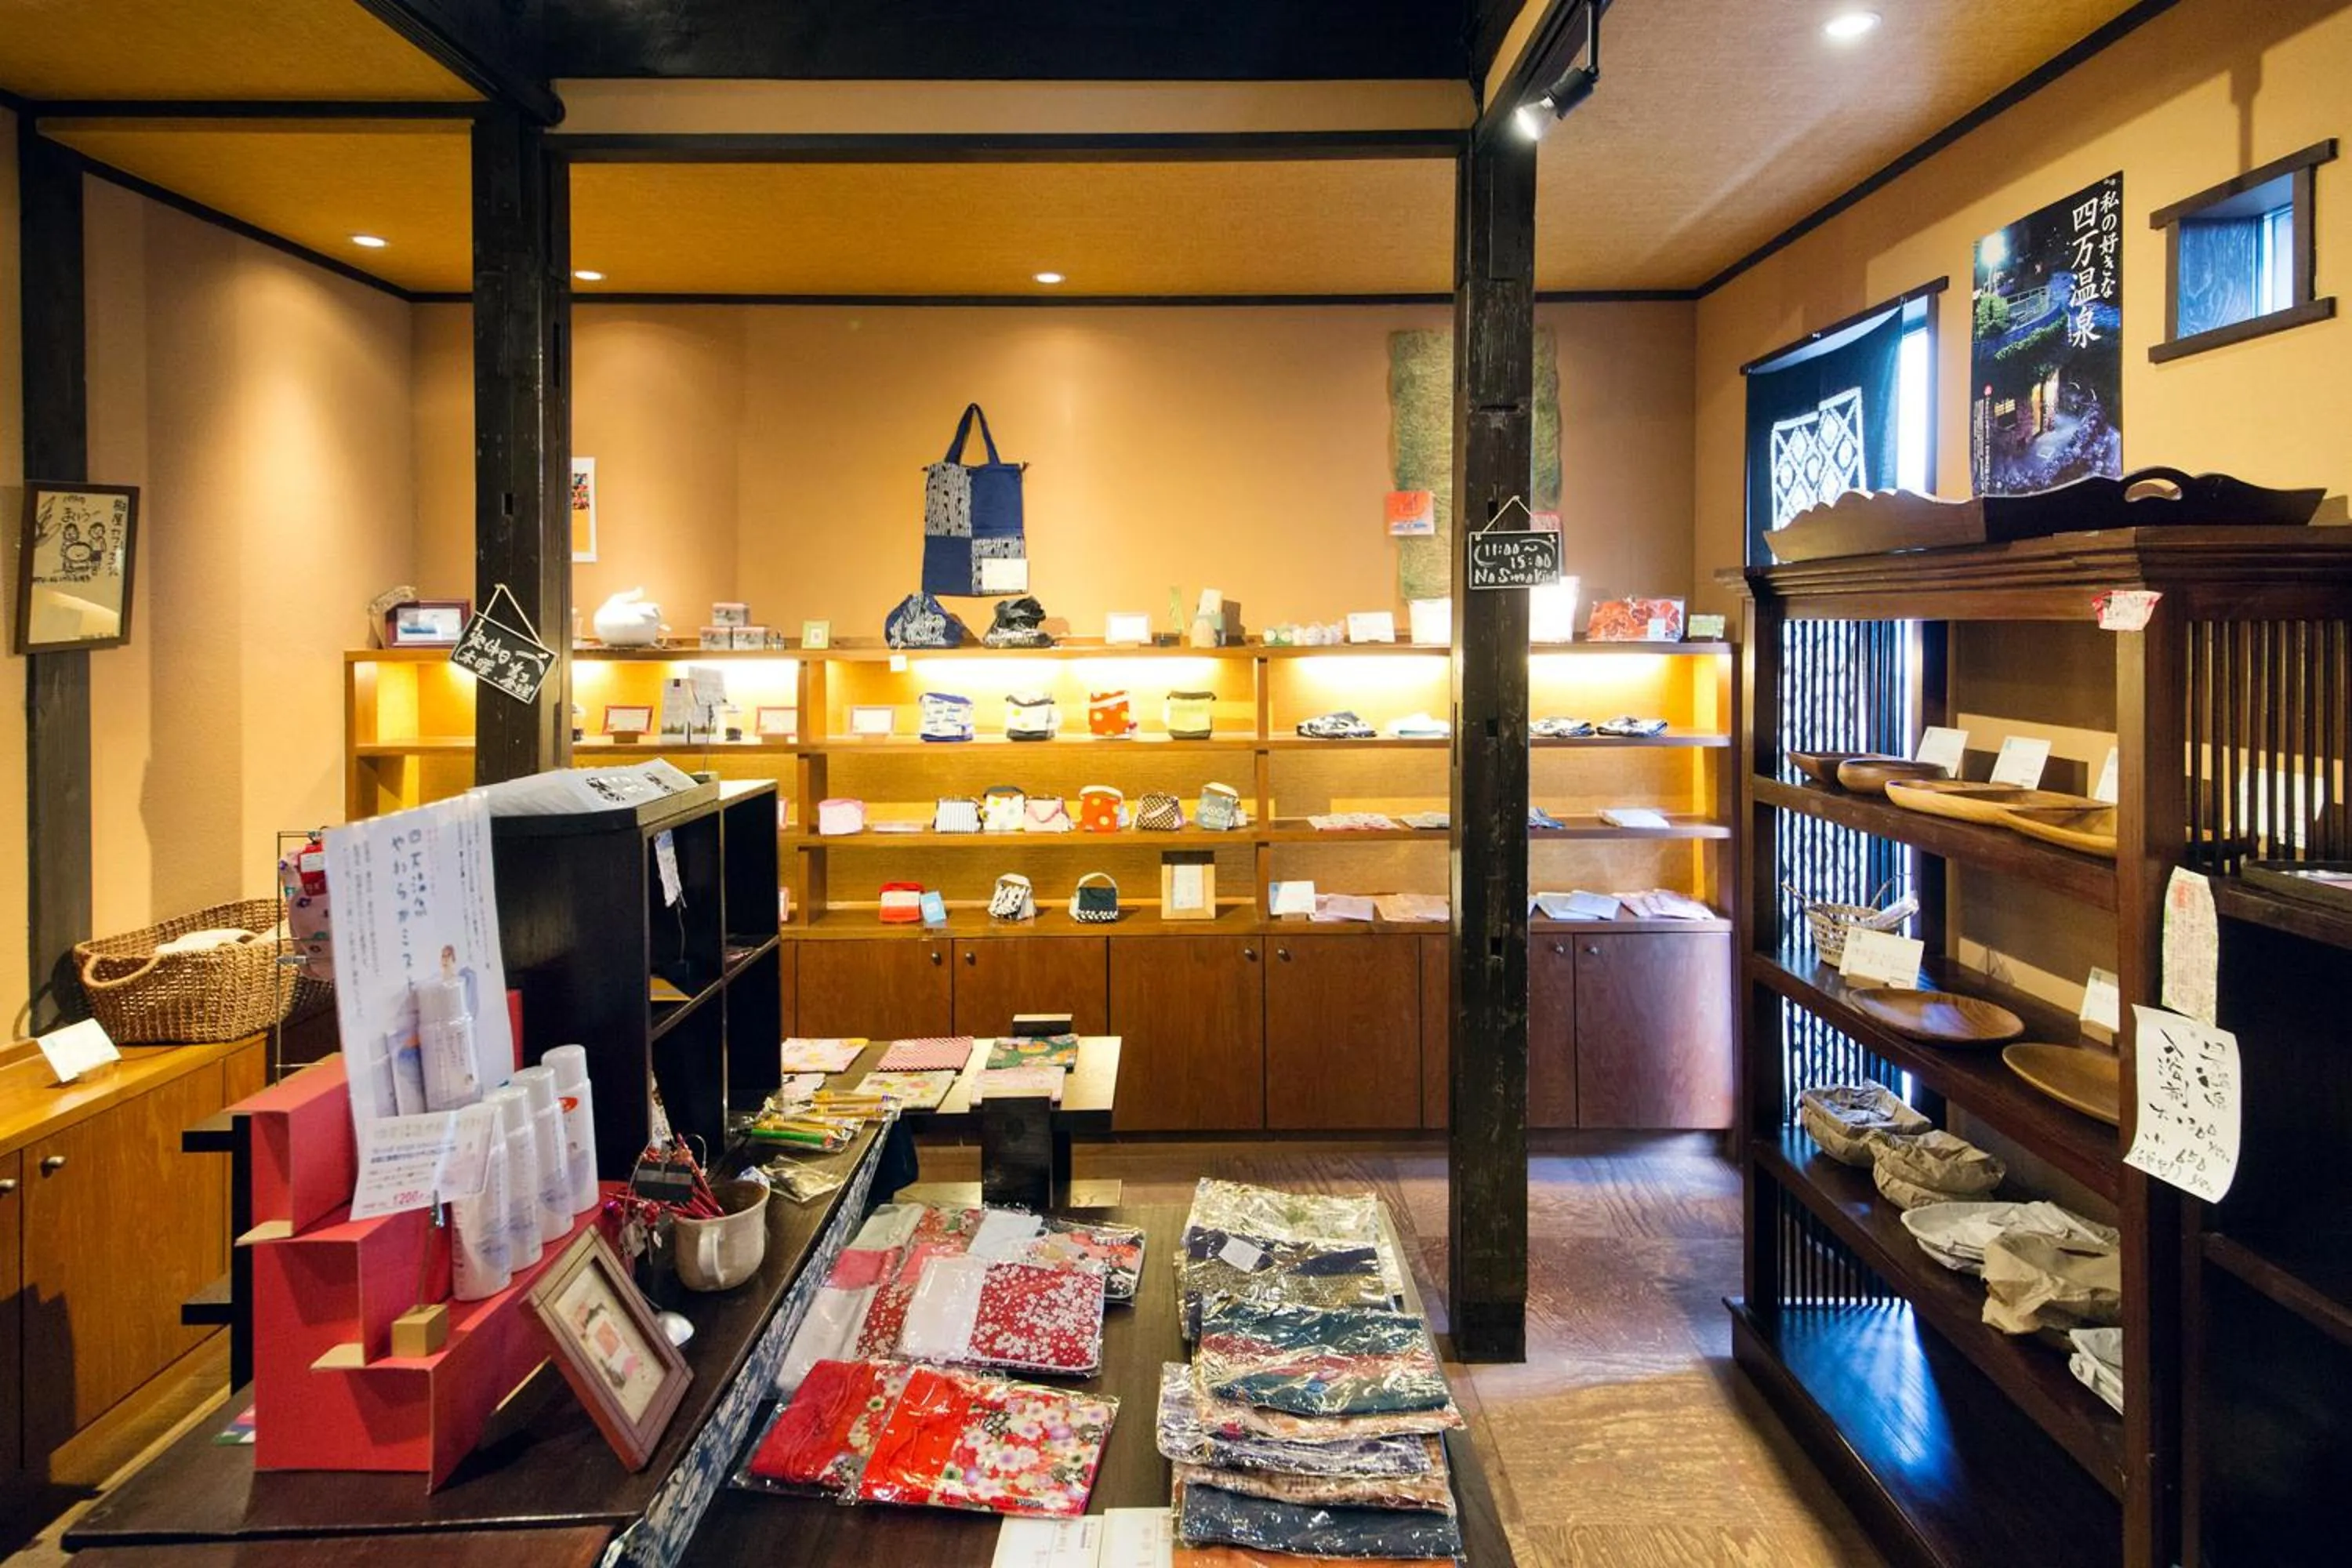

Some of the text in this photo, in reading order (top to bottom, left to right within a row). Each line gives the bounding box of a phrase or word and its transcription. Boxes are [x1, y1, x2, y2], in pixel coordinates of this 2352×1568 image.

[2069, 197, 2102, 349] 四万温泉
[2100, 191, 2120, 299] 私の好きな
[1475, 568, 1495, 584] No
